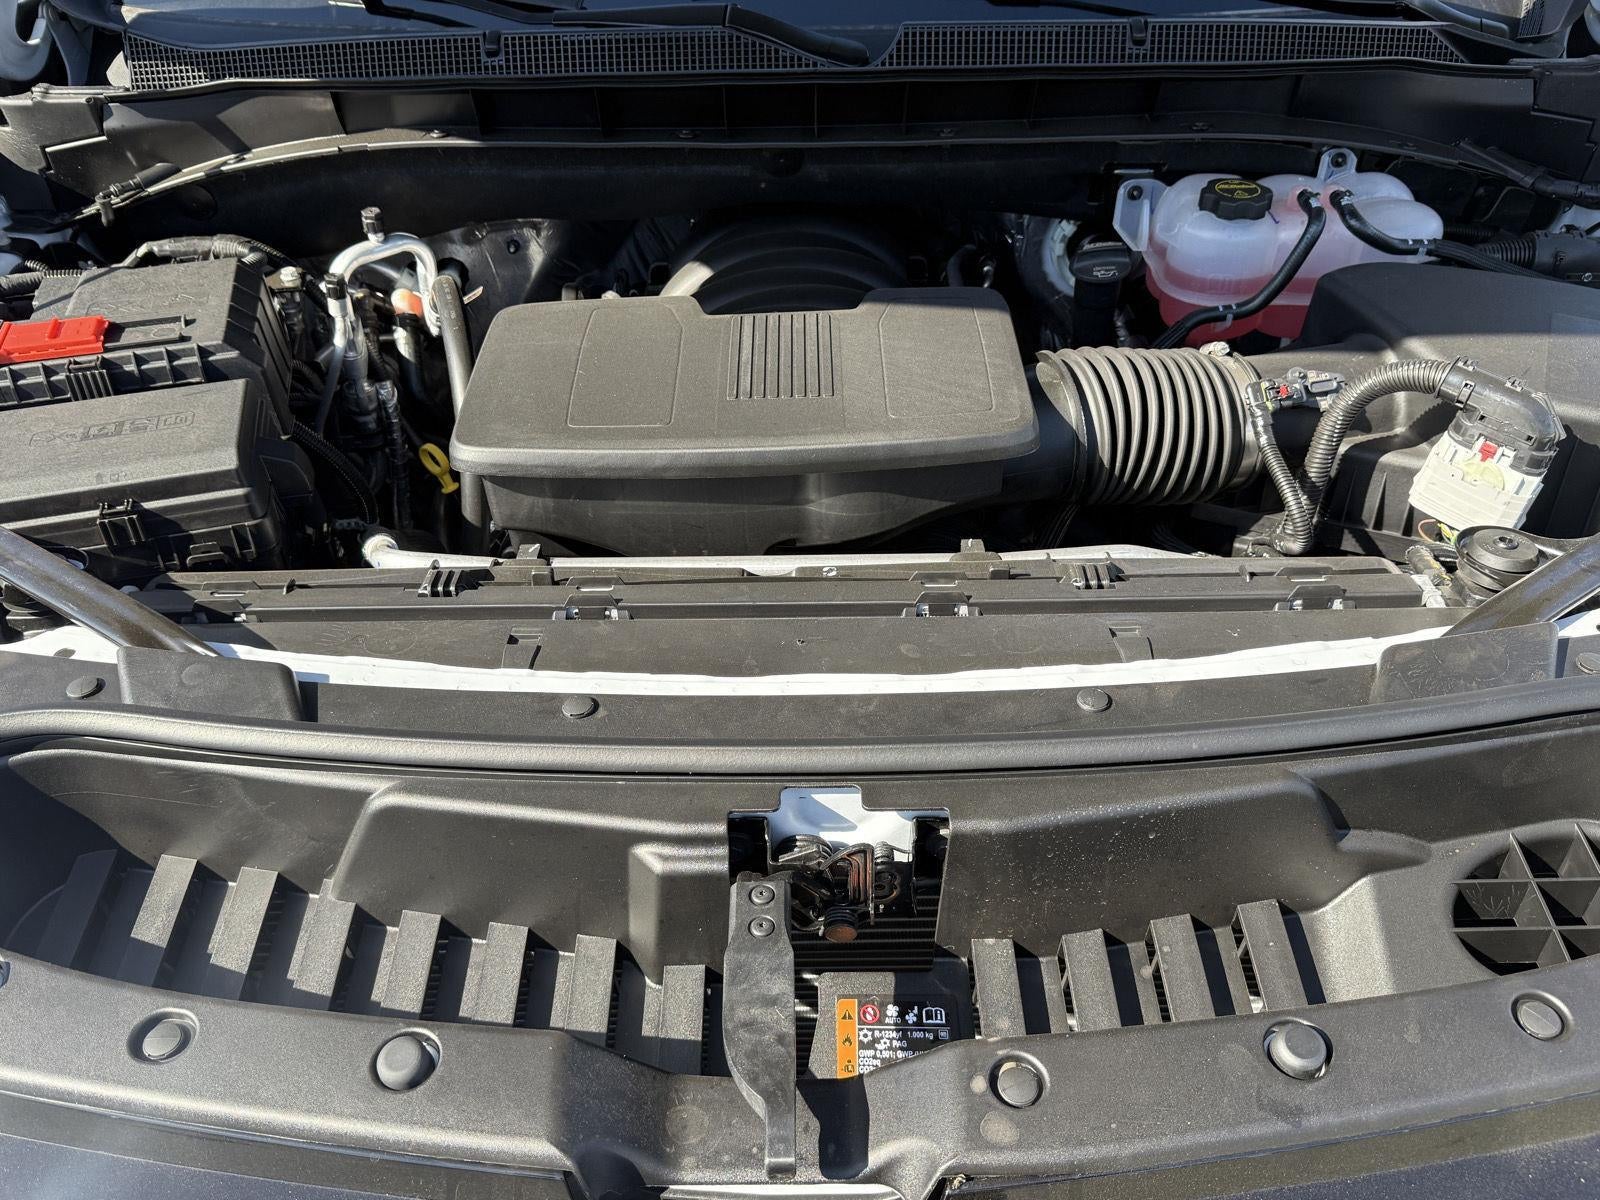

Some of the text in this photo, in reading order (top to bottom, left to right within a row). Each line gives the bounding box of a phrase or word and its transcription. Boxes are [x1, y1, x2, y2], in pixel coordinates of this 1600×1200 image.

[874, 1030, 902, 1039] R-1234yf
[925, 1031, 934, 1040] kg
[892, 1040, 907, 1048] PAG
[859, 1050, 875, 1058] GWP
[897, 1050, 913, 1058] GWP
[859, 1058, 881, 1067] CO2eq
